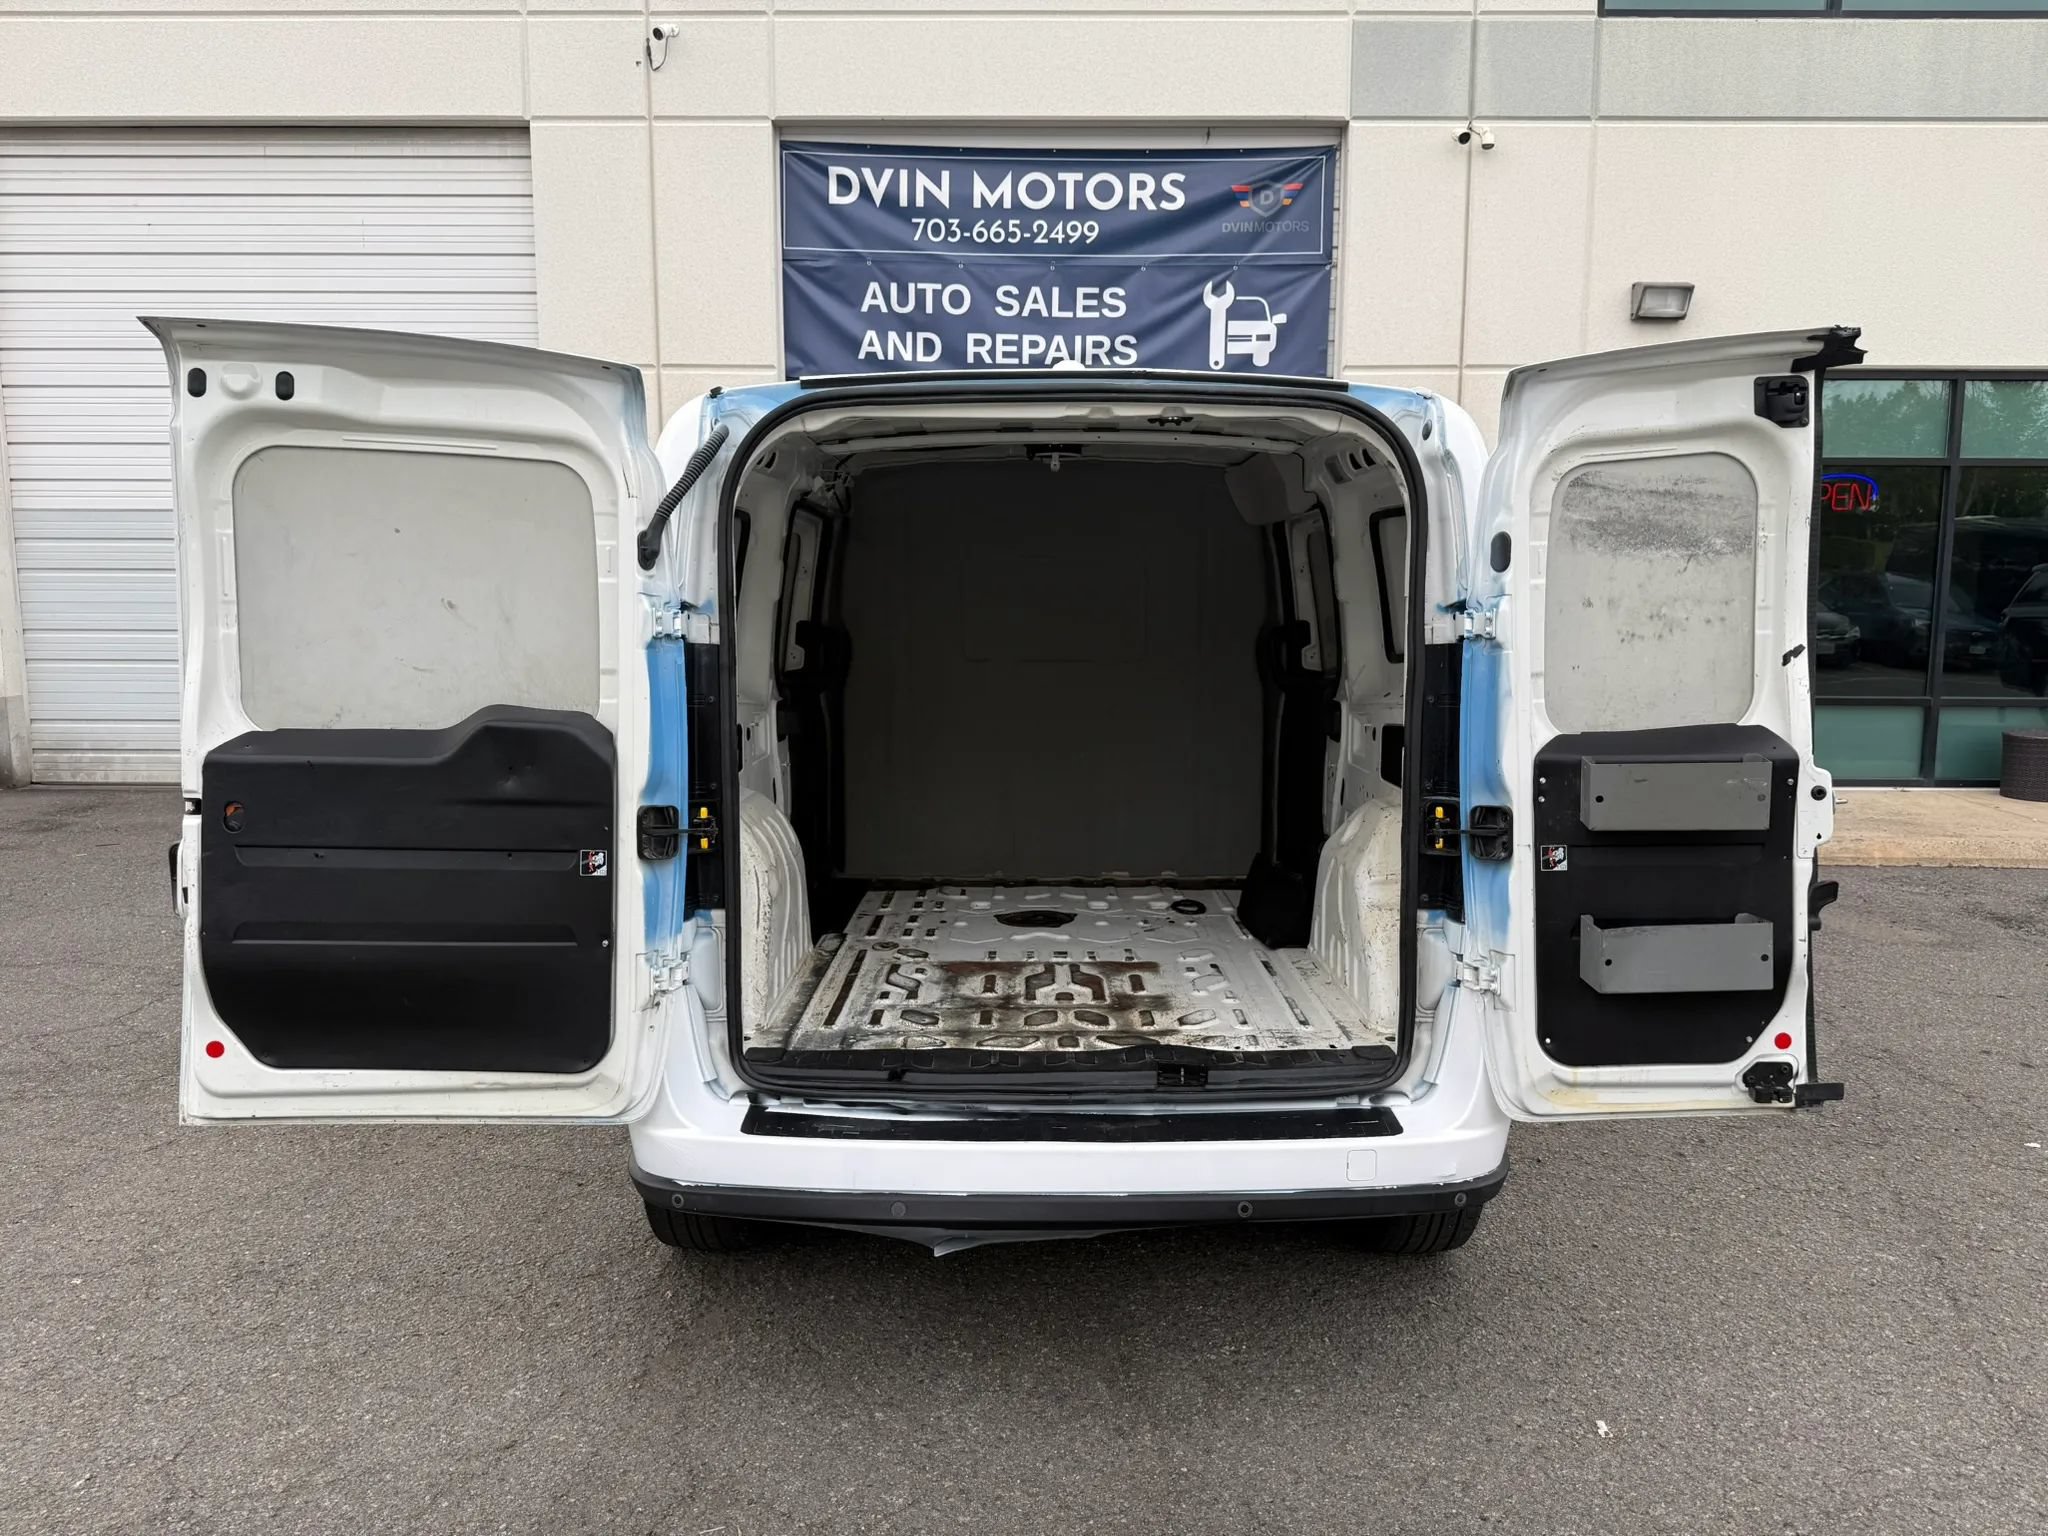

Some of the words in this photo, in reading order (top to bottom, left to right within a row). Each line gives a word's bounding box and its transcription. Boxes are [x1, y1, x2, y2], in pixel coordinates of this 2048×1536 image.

[827, 166, 950, 209] DVIN
[973, 171, 1186, 211] MOTORS
[911, 218, 1100, 244] 703-665-2499
[860, 281, 971, 315] AUTO
[994, 285, 1127, 318] SALES
[858, 329, 942, 363] AND
[966, 333, 1138, 366] REPAIRS
[1820, 482, 1873, 512] PEN
